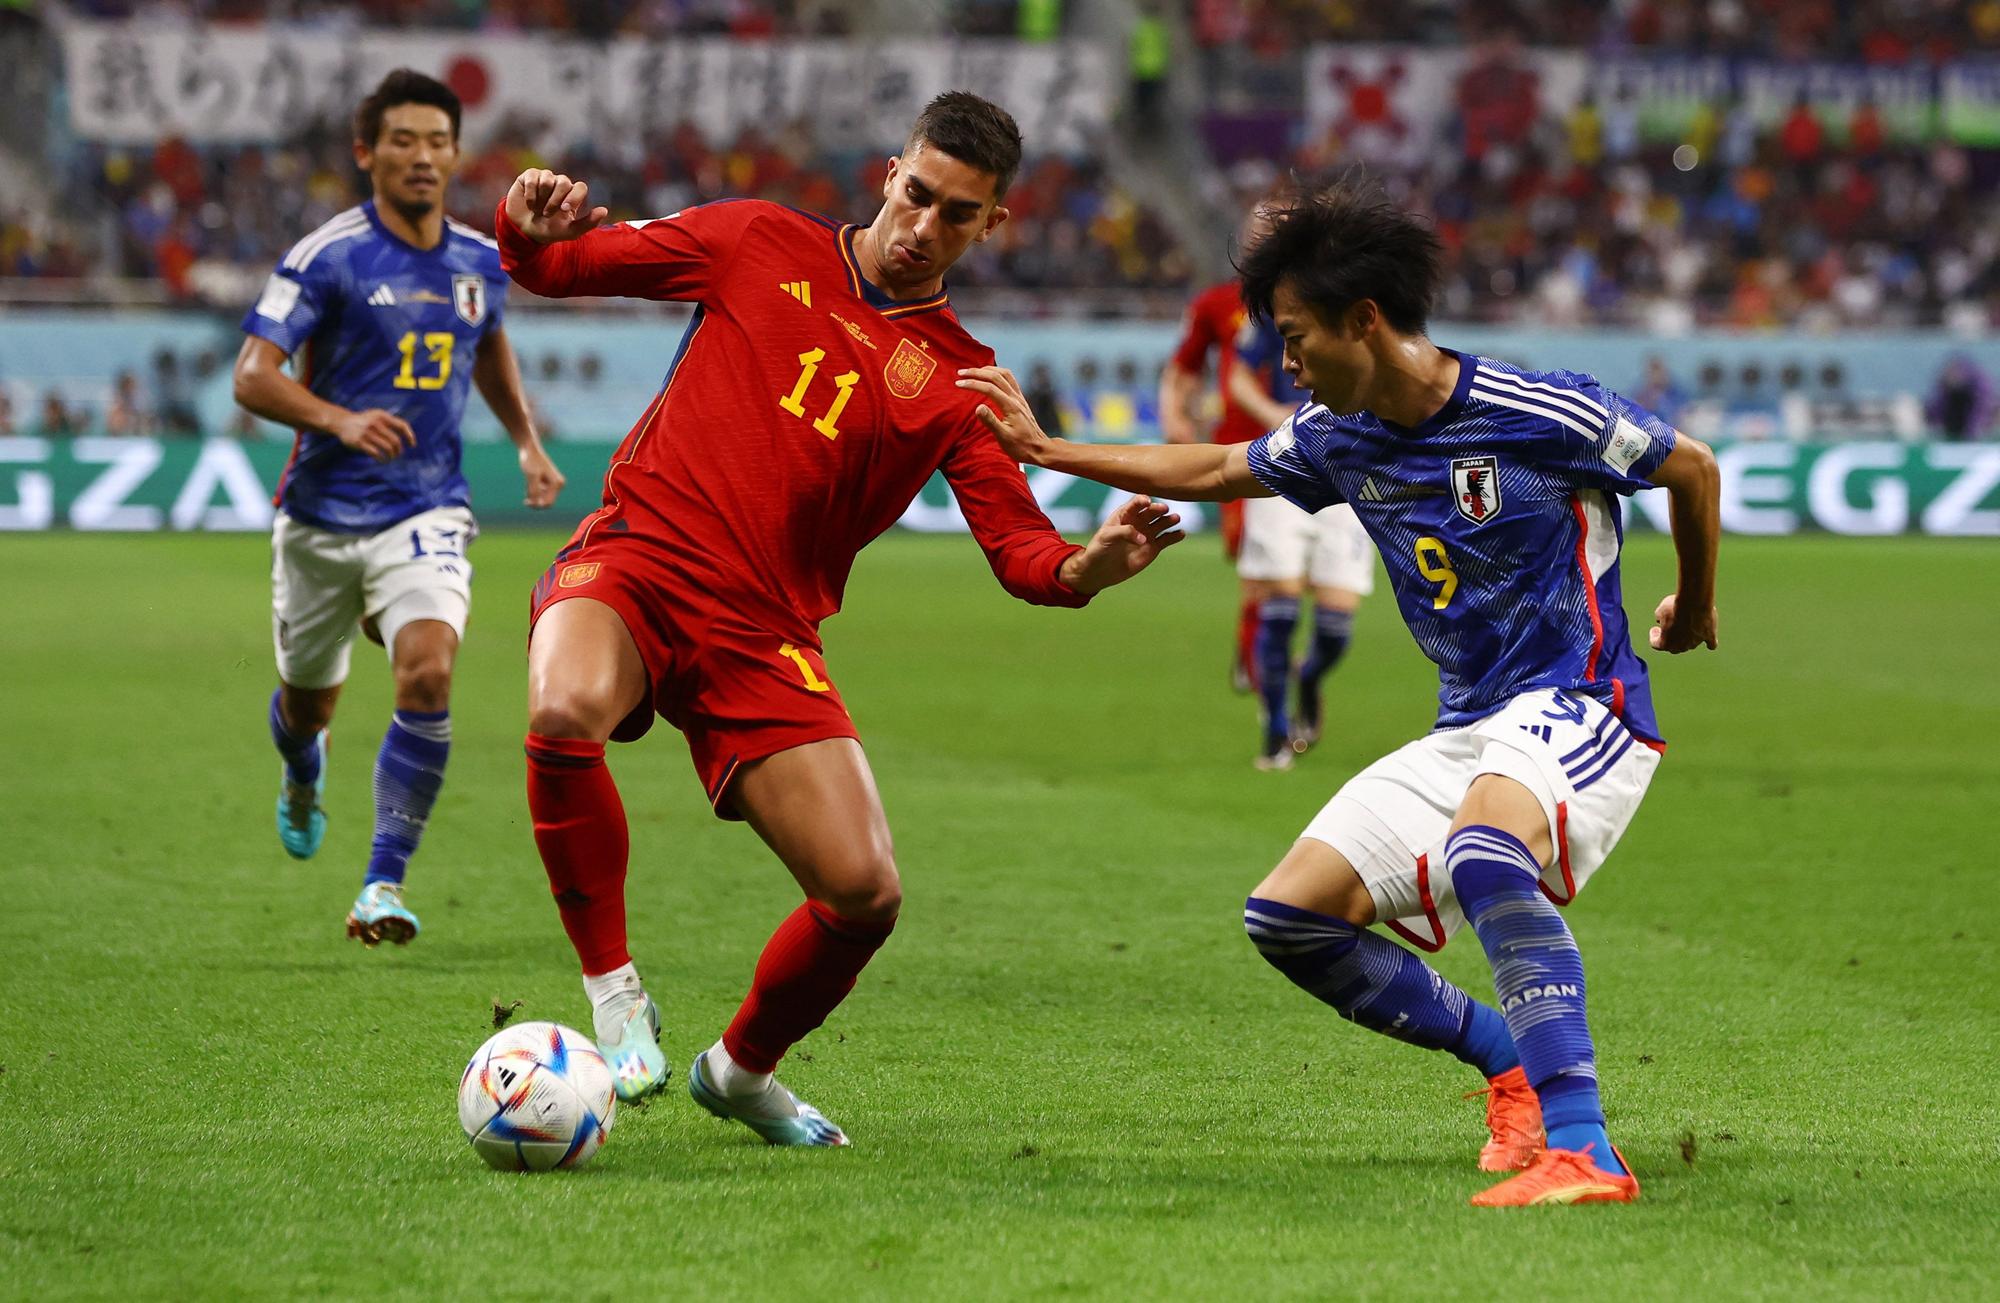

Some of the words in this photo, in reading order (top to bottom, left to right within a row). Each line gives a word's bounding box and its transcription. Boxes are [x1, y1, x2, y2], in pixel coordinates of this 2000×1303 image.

[393, 331, 455, 390] 13
[779, 347, 860, 440] 11
[1461, 459, 1485, 468] JAPAN
[1414, 536, 1458, 609] 9
